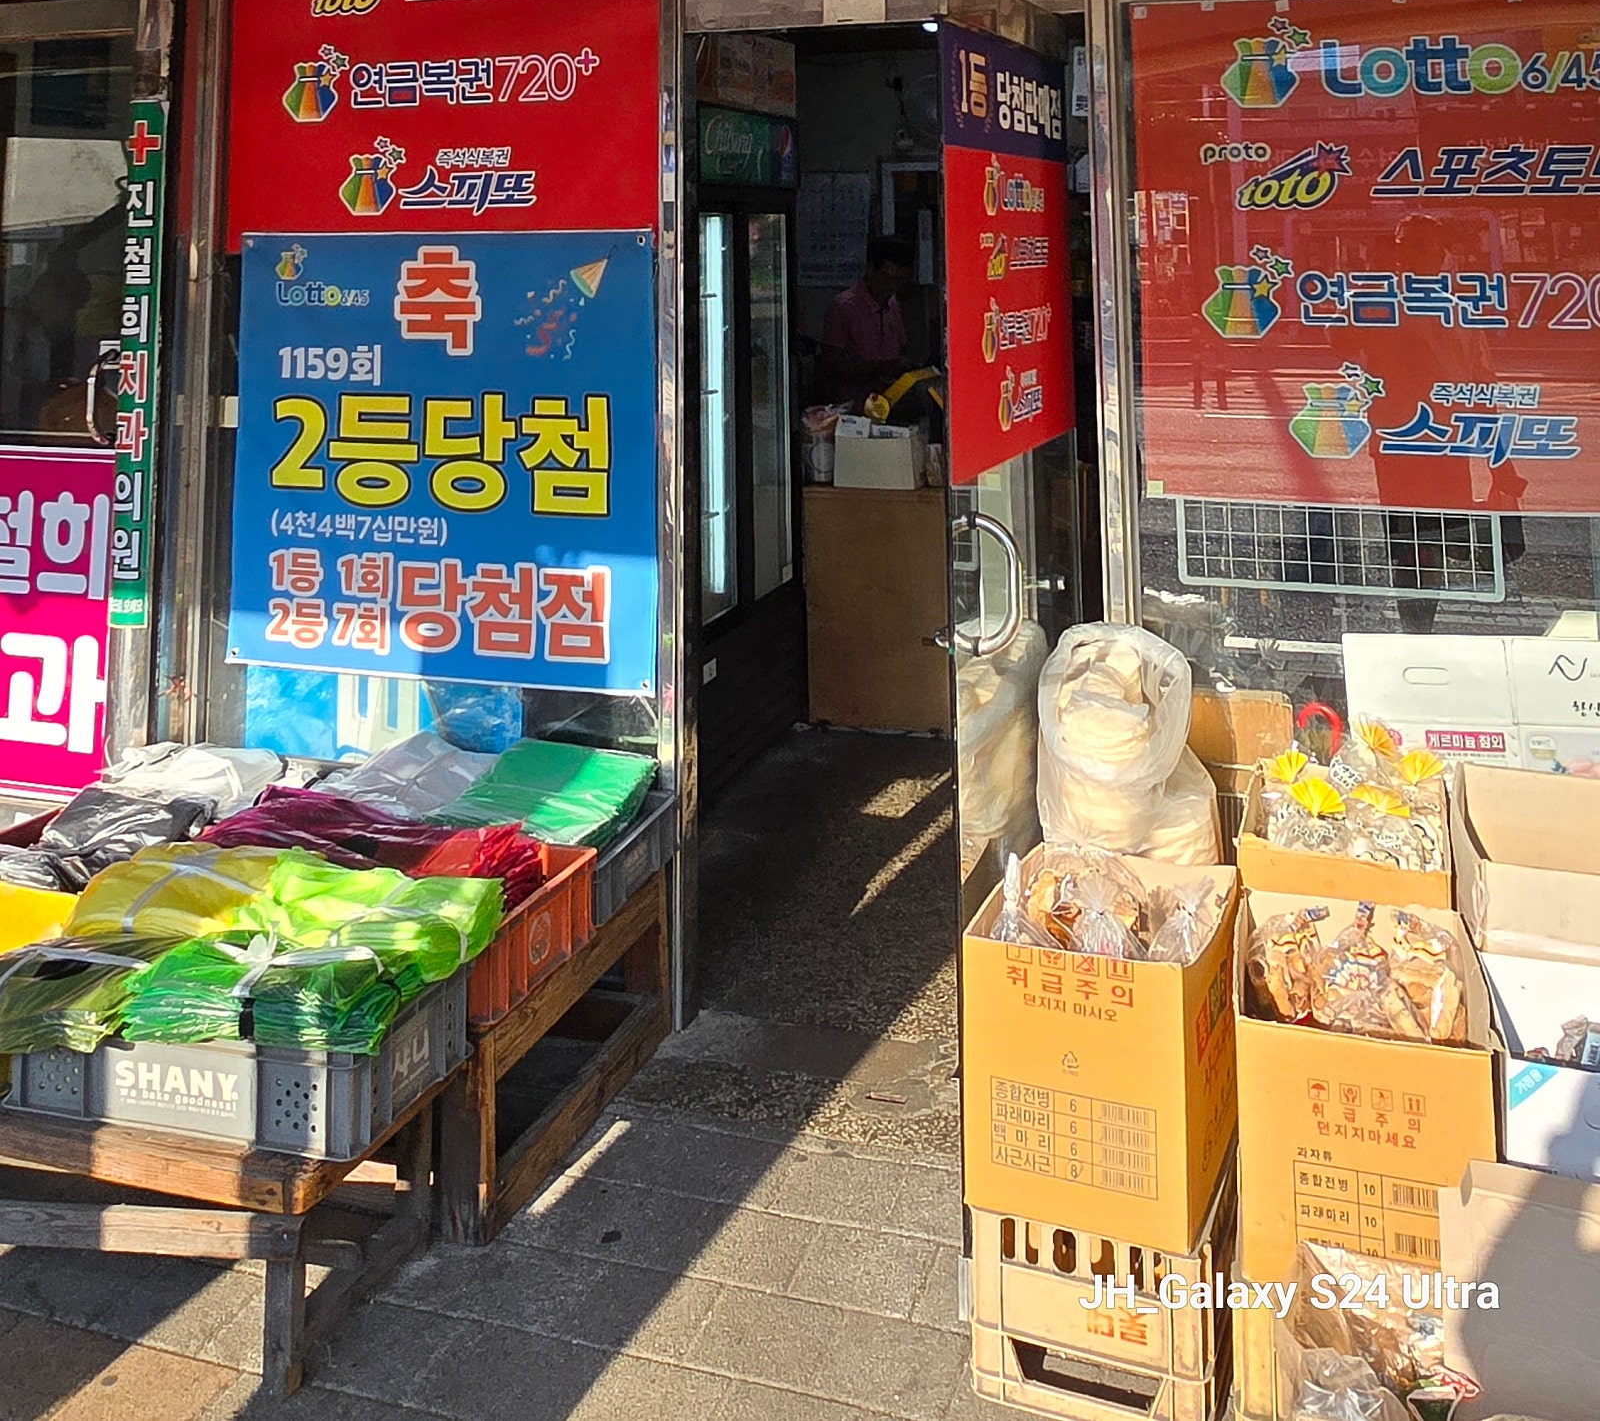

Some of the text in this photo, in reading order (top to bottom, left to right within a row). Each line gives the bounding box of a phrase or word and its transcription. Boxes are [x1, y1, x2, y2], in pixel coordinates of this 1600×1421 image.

[996, 71, 1062, 141] 당첨판매점
[436, 147, 512, 168] 즉석식복권
[1200, 141, 1272, 165] proto
[399, 165, 537, 216] 스피또
[1236, 166, 1338, 211] toto
[394, 245, 483, 357] 축
[278, 344, 383, 386] 1159회
[1430, 382, 1541, 409] 즉석식복권
[1376, 401, 1582, 469] 스피또
[271, 392, 613, 519] 2등당첨
[271, 510, 449, 547] (4천4백7십만원)
[268, 547, 395, 601] 1등 1회
[264, 597, 392, 656] 2등 7회
[393, 557, 612, 665] 당첨점
[1022, 993, 1119, 1023] 던지지 마시오
[994, 1080, 1078, 1113] 종합전병 6
[995, 1102, 1078, 1135] 파래마리 6
[995, 1145, 1052, 1175] 사근사근
[1070, 1142, 1078, 1157] 6
[1296, 1146, 1333, 1164] 과자류
[1299, 1171, 1376, 1196] 종합전병 10
[1300, 1204, 1378, 1229] 파래마리 10
